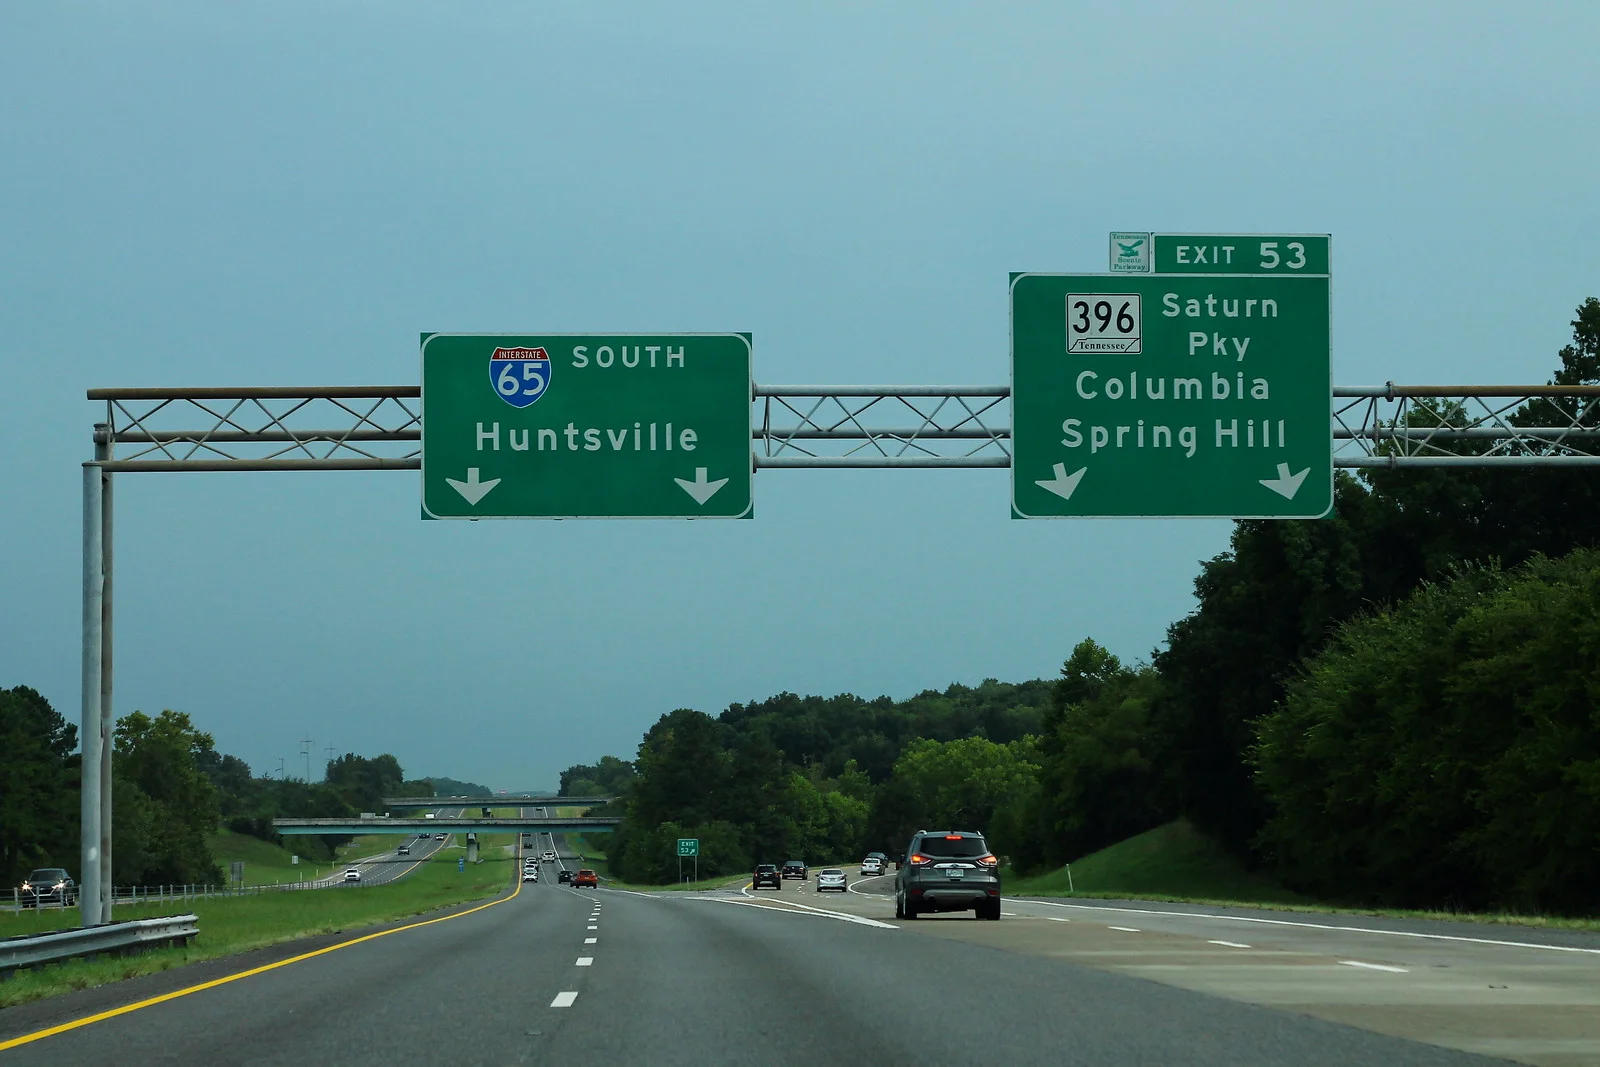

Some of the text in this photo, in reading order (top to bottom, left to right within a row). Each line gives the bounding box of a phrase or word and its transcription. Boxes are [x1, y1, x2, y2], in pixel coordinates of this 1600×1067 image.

[1176, 242, 1307, 269] EXIT 53
[1072, 300, 1134, 334] 396
[1161, 293, 1278, 317] Saturn
[498, 350, 541, 359] INTERSTATE
[572, 345, 685, 368] SOUTH
[1078, 341, 1126, 350] Tennessee
[1188, 331, 1251, 361] Pky
[497, 362, 545, 396] 65
[1075, 370, 1270, 400] Columbia
[475, 421, 699, 451] Huntsville
[1061, 418, 1286, 458] Spring Hill
